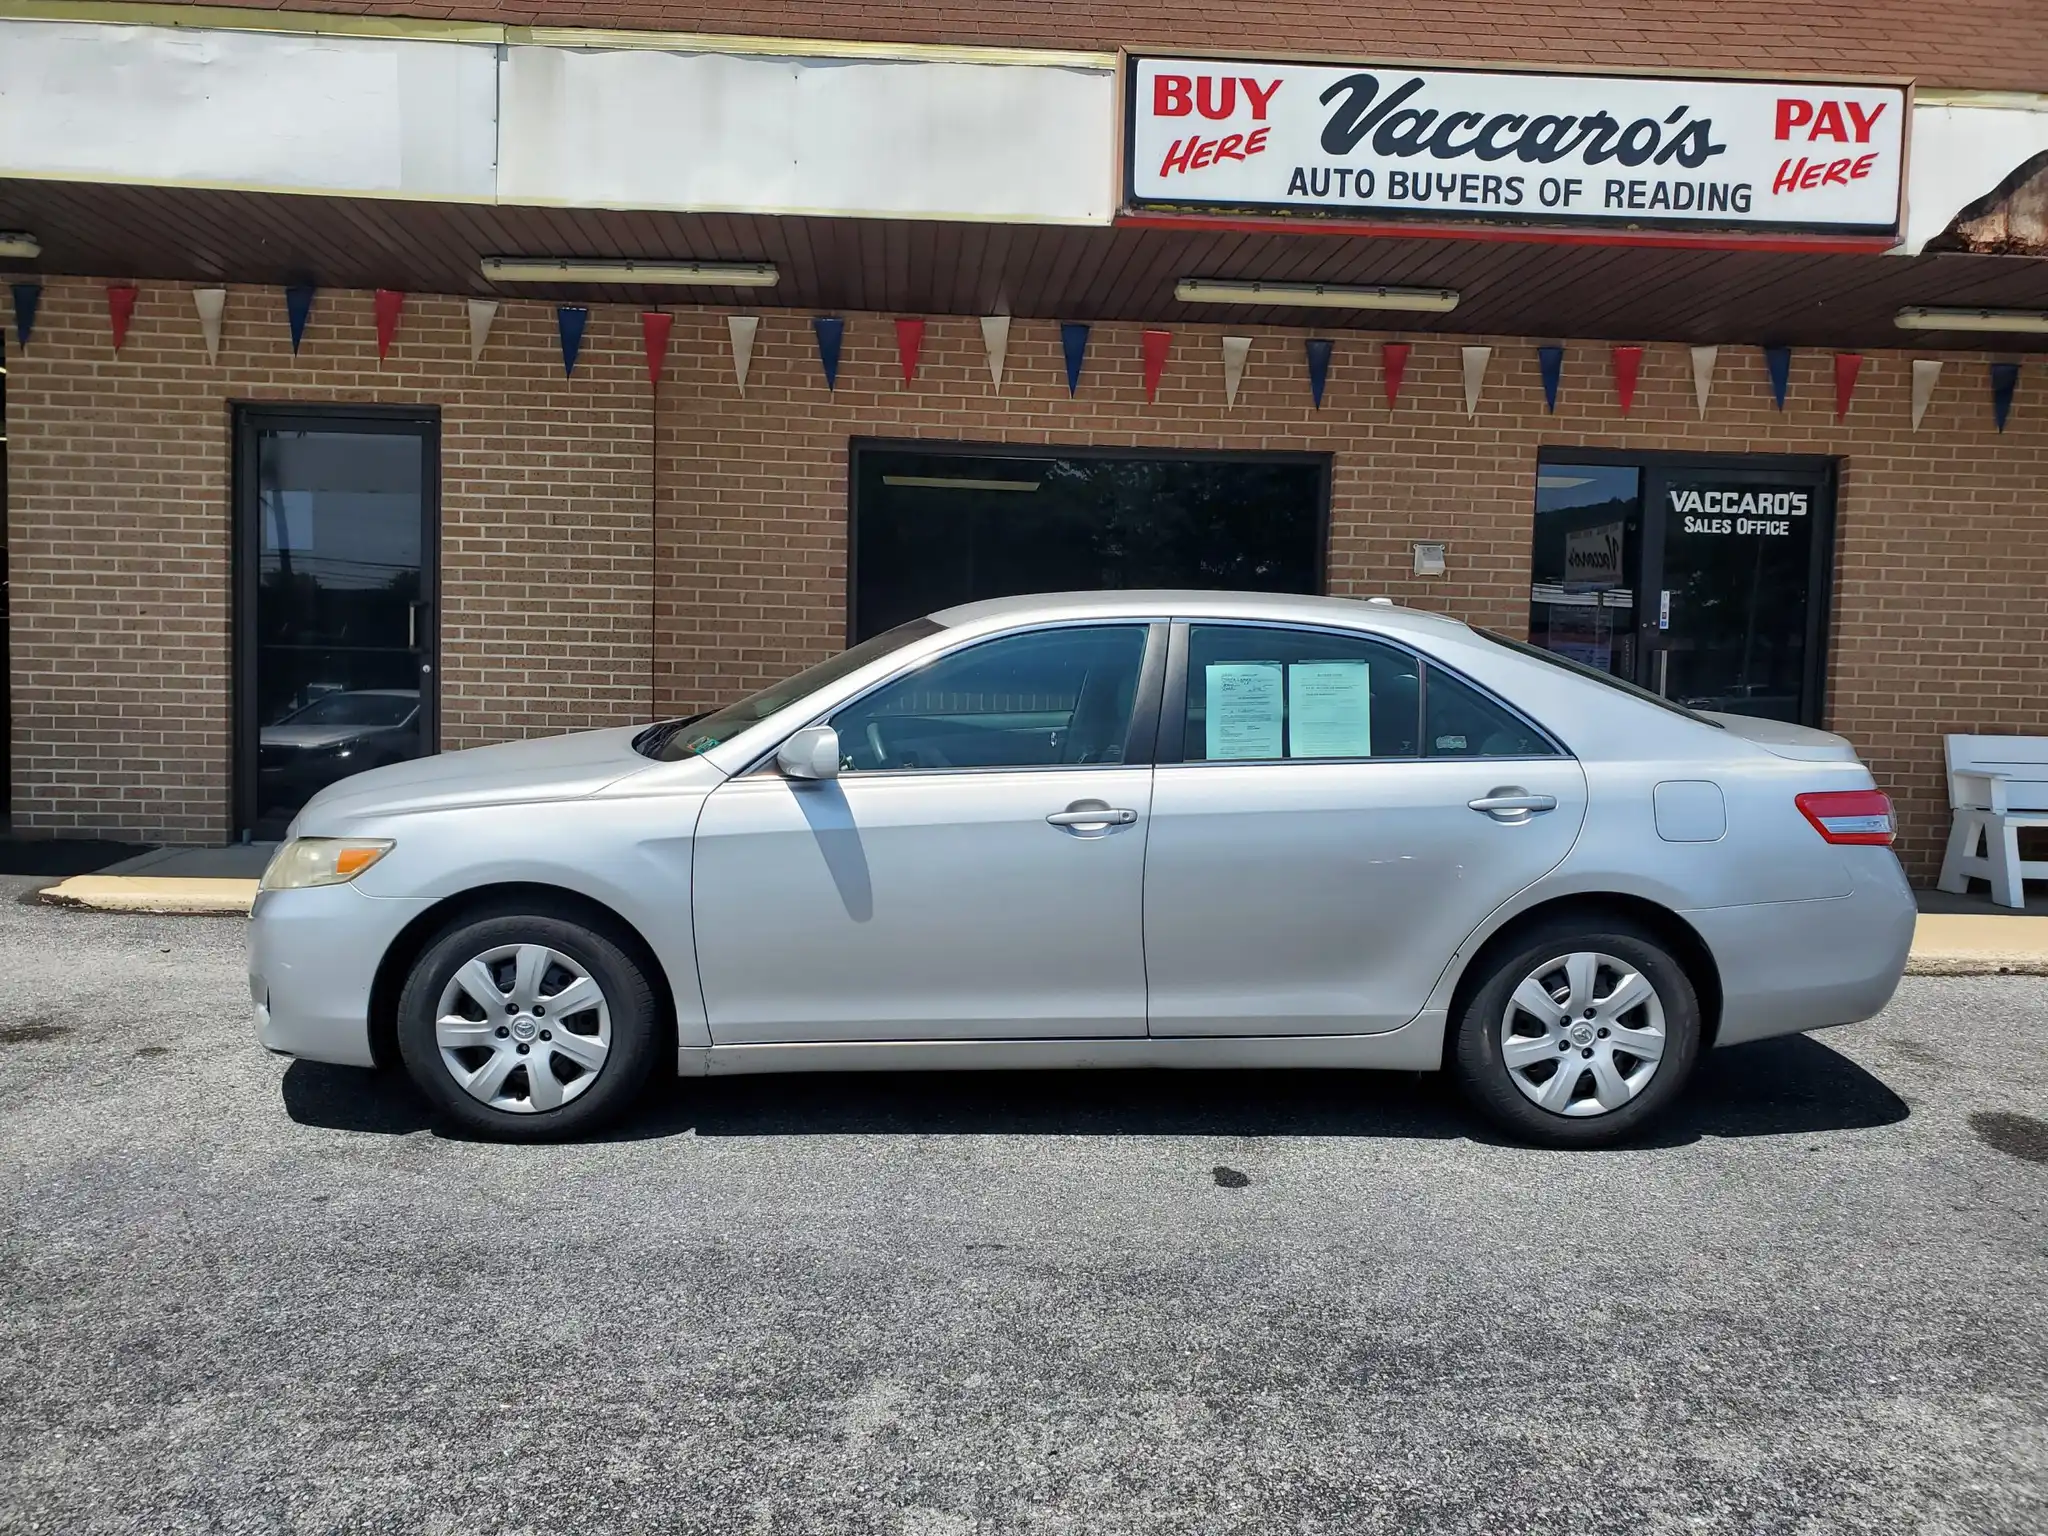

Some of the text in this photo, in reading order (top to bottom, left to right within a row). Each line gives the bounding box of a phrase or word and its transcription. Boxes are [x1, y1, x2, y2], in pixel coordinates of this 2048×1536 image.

[1153, 74, 1284, 121] BUY
[1319, 73, 1727, 168] Vaccaro's
[1775, 99, 1888, 144] PAY
[1159, 126, 1272, 178] HERE
[1772, 152, 1880, 196] HERE
[1287, 167, 1751, 212] AUTO BUYERS OF READING
[1671, 491, 1807, 517] VACCARO'S
[1685, 516, 1790, 536] SALES OFFICE
